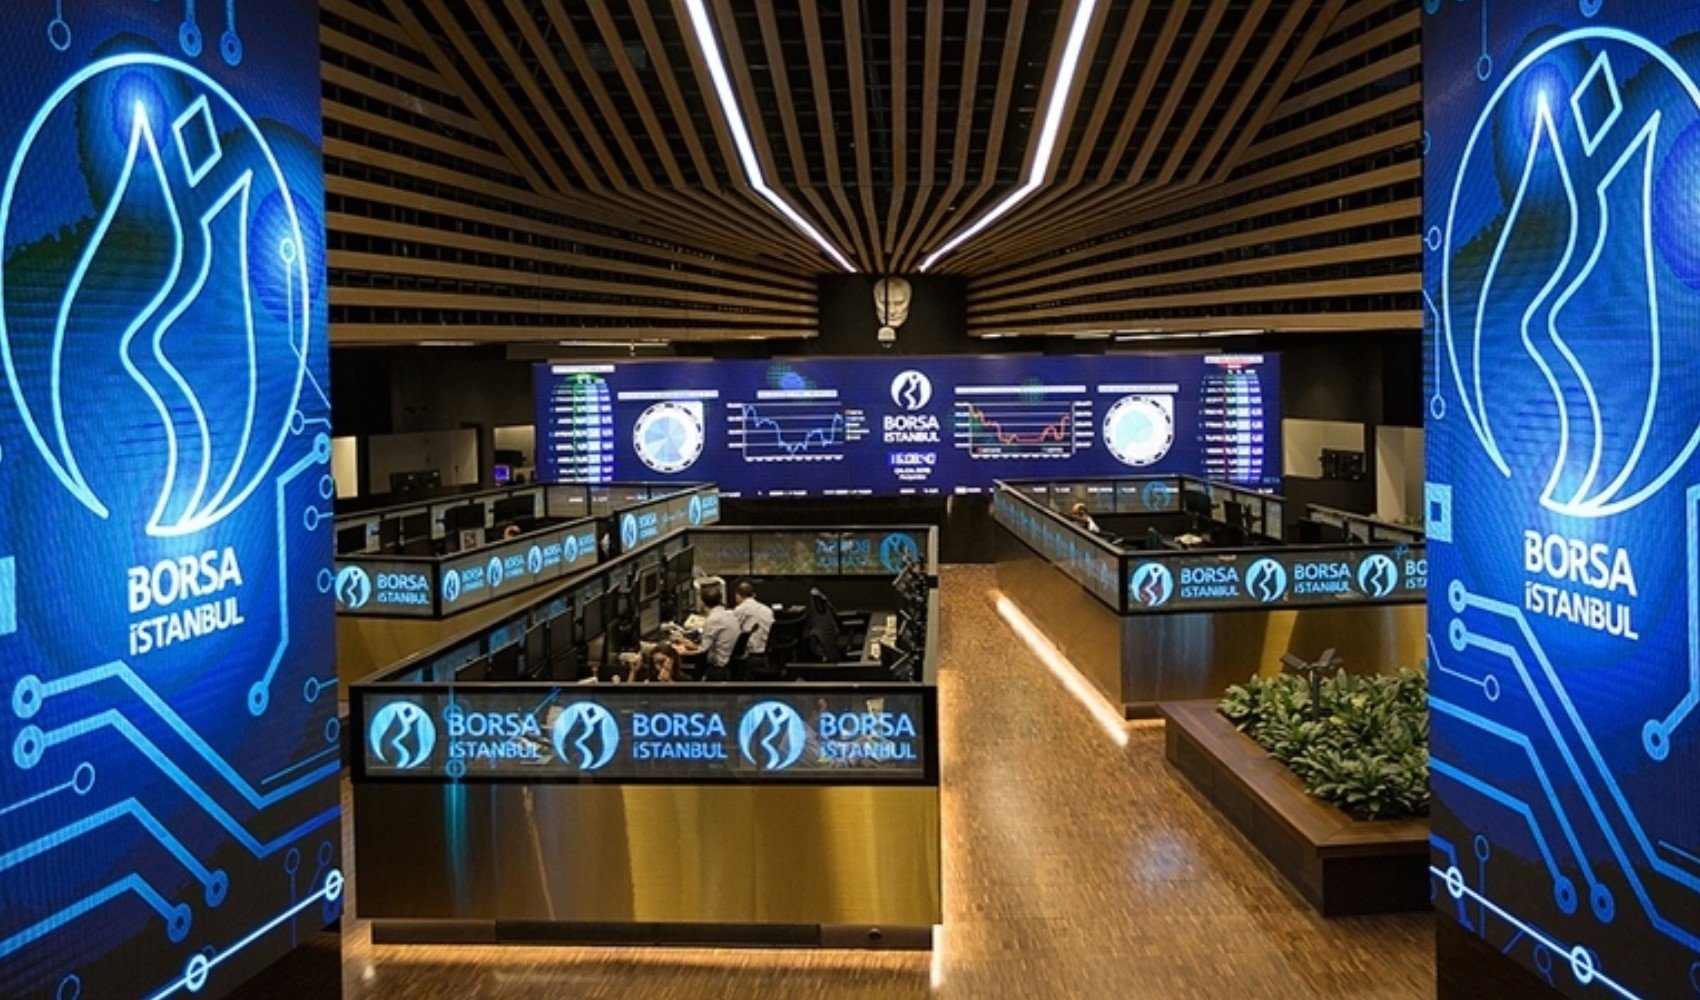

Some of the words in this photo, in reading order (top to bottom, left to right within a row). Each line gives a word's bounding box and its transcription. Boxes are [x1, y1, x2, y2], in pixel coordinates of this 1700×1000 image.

[883, 415, 940, 431] BORSA
[1181, 567, 1240, 584] BORSA
[1293, 563, 1351, 580] BORSA
[1526, 530, 1638, 597] BORSA
[128, 547, 243, 613] BORSA
[377, 573, 429, 591] BORSA
[449, 712, 541, 737] BORSA
[633, 712, 727, 737] BORSA
[820, 712, 916, 737] BORSA
